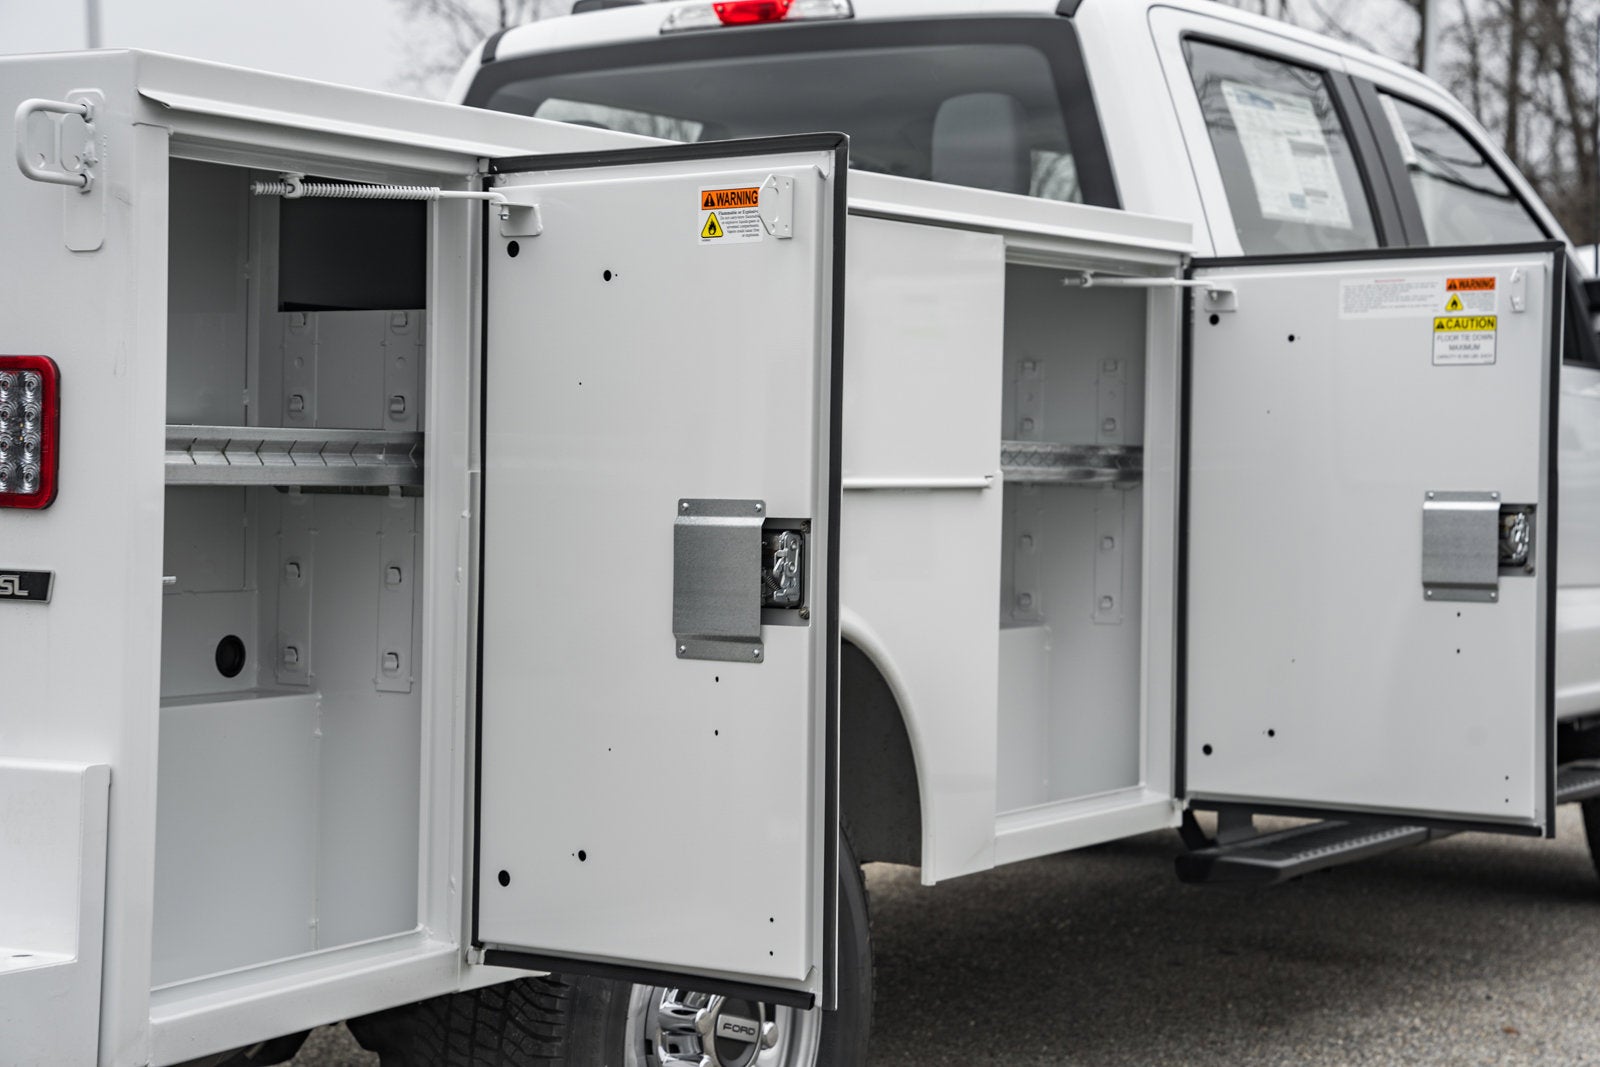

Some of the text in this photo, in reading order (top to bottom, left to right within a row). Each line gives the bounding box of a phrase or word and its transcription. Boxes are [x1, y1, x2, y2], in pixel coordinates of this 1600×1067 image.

[716, 190, 758, 206] WARNING
[1459, 280, 1495, 290] WARNING
[1446, 318, 1494, 329] CAUTION
[723, 1022, 756, 1036] FORD
